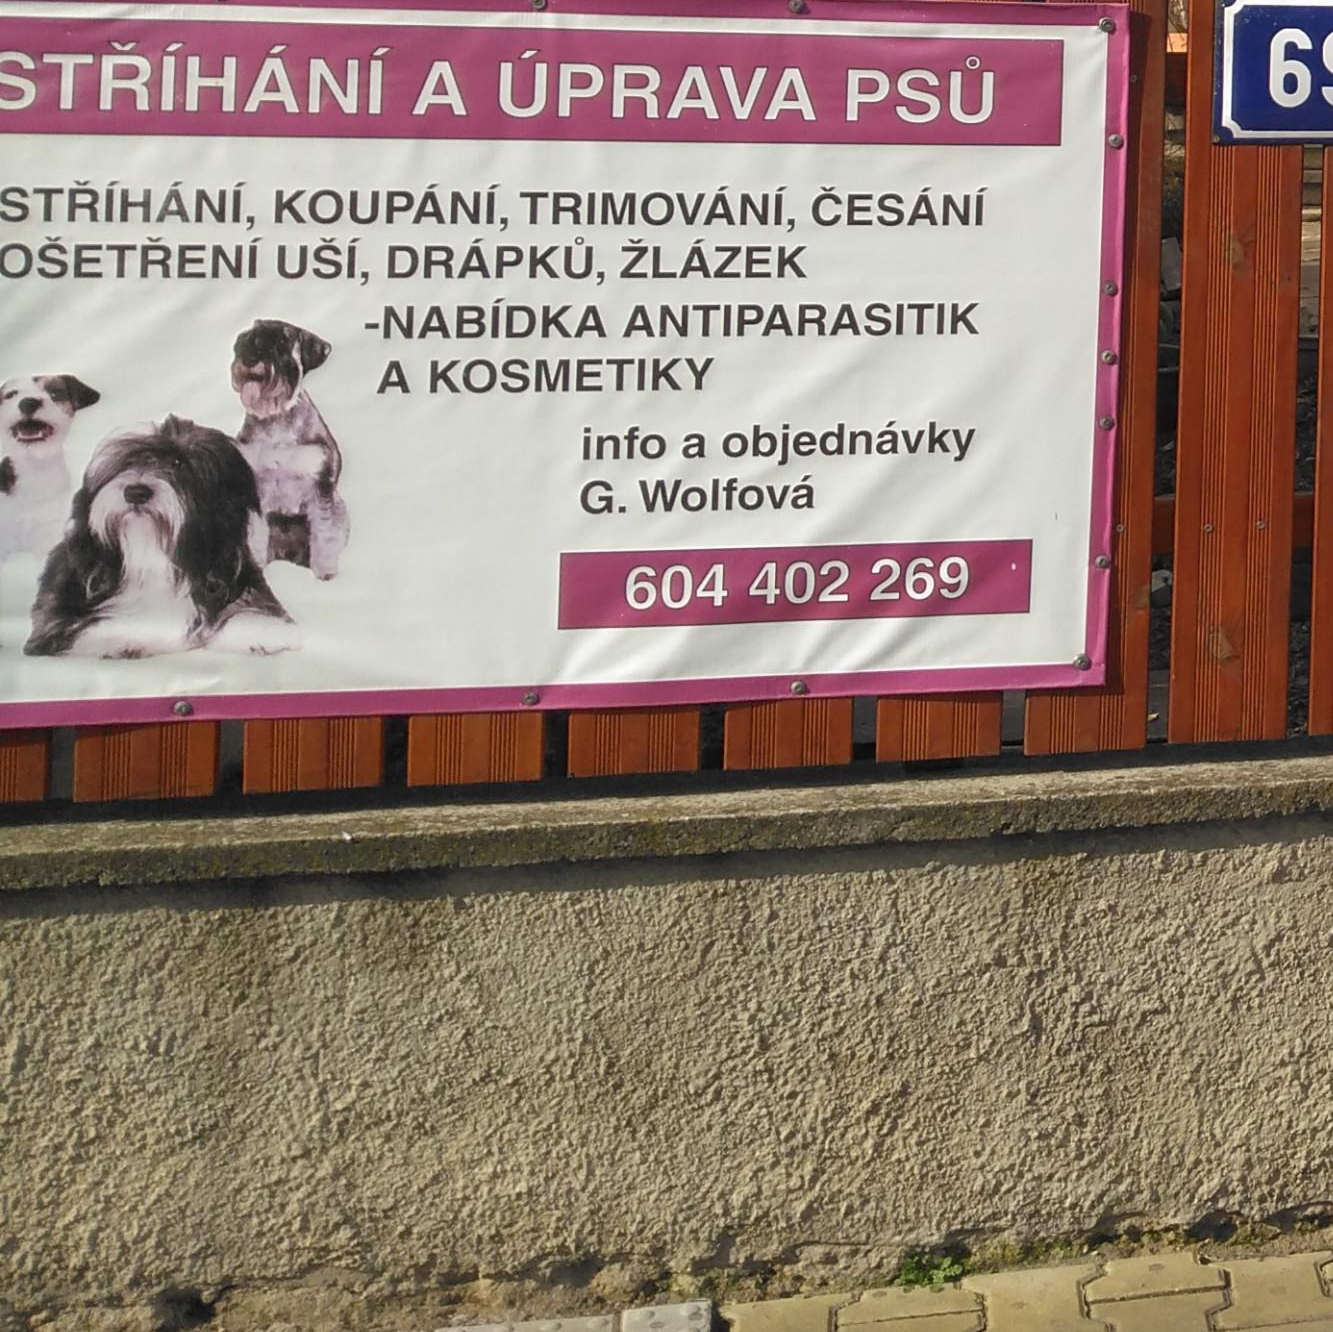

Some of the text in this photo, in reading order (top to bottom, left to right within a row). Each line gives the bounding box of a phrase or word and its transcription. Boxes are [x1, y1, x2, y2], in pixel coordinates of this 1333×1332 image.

[0, 41, 995, 125] STŘÍHÁNÍ A ÚPRAVA PSŮ
[0, 180, 987, 232] STŘÍHÁNÍ, KOUPÁNÍ, TRIMOVÁNÍ, ČESÁNÍ
[0, 236, 808, 285] OŠETŘENÍ UŠÍ, DRÁPKŮ, ŽLÁZEK
[364, 297, 980, 340] -NABÍDKA ANTIPARASITIK
[376, 357, 714, 395] A KOSMETIKY
[581, 420, 976, 465] info a objednávky
[579, 474, 816, 516] G. Wolfová
[624, 555, 970, 611] 604 402 269
